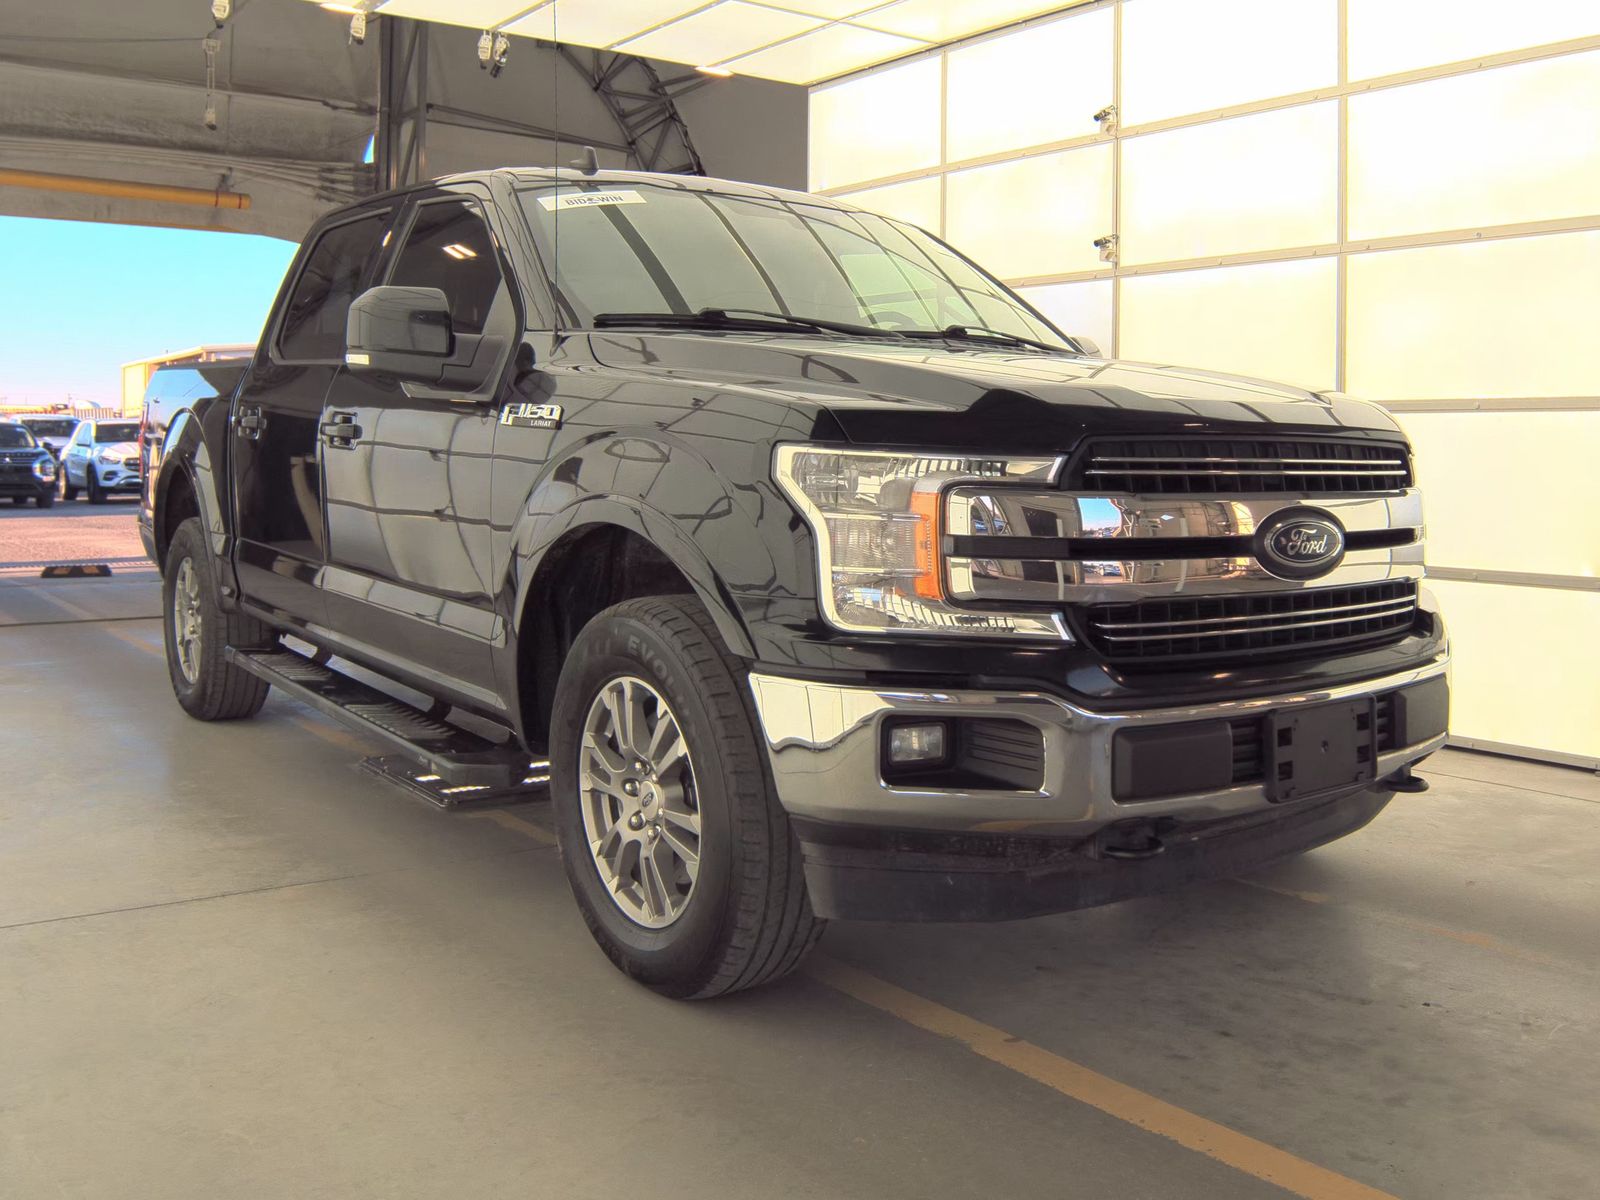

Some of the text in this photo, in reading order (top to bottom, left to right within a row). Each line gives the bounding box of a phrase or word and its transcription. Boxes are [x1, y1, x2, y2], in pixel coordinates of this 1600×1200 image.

[565, 195, 624, 206] BID WIN
[530, 420, 552, 428] LARIAT
[1287, 528, 1328, 556] Ford
